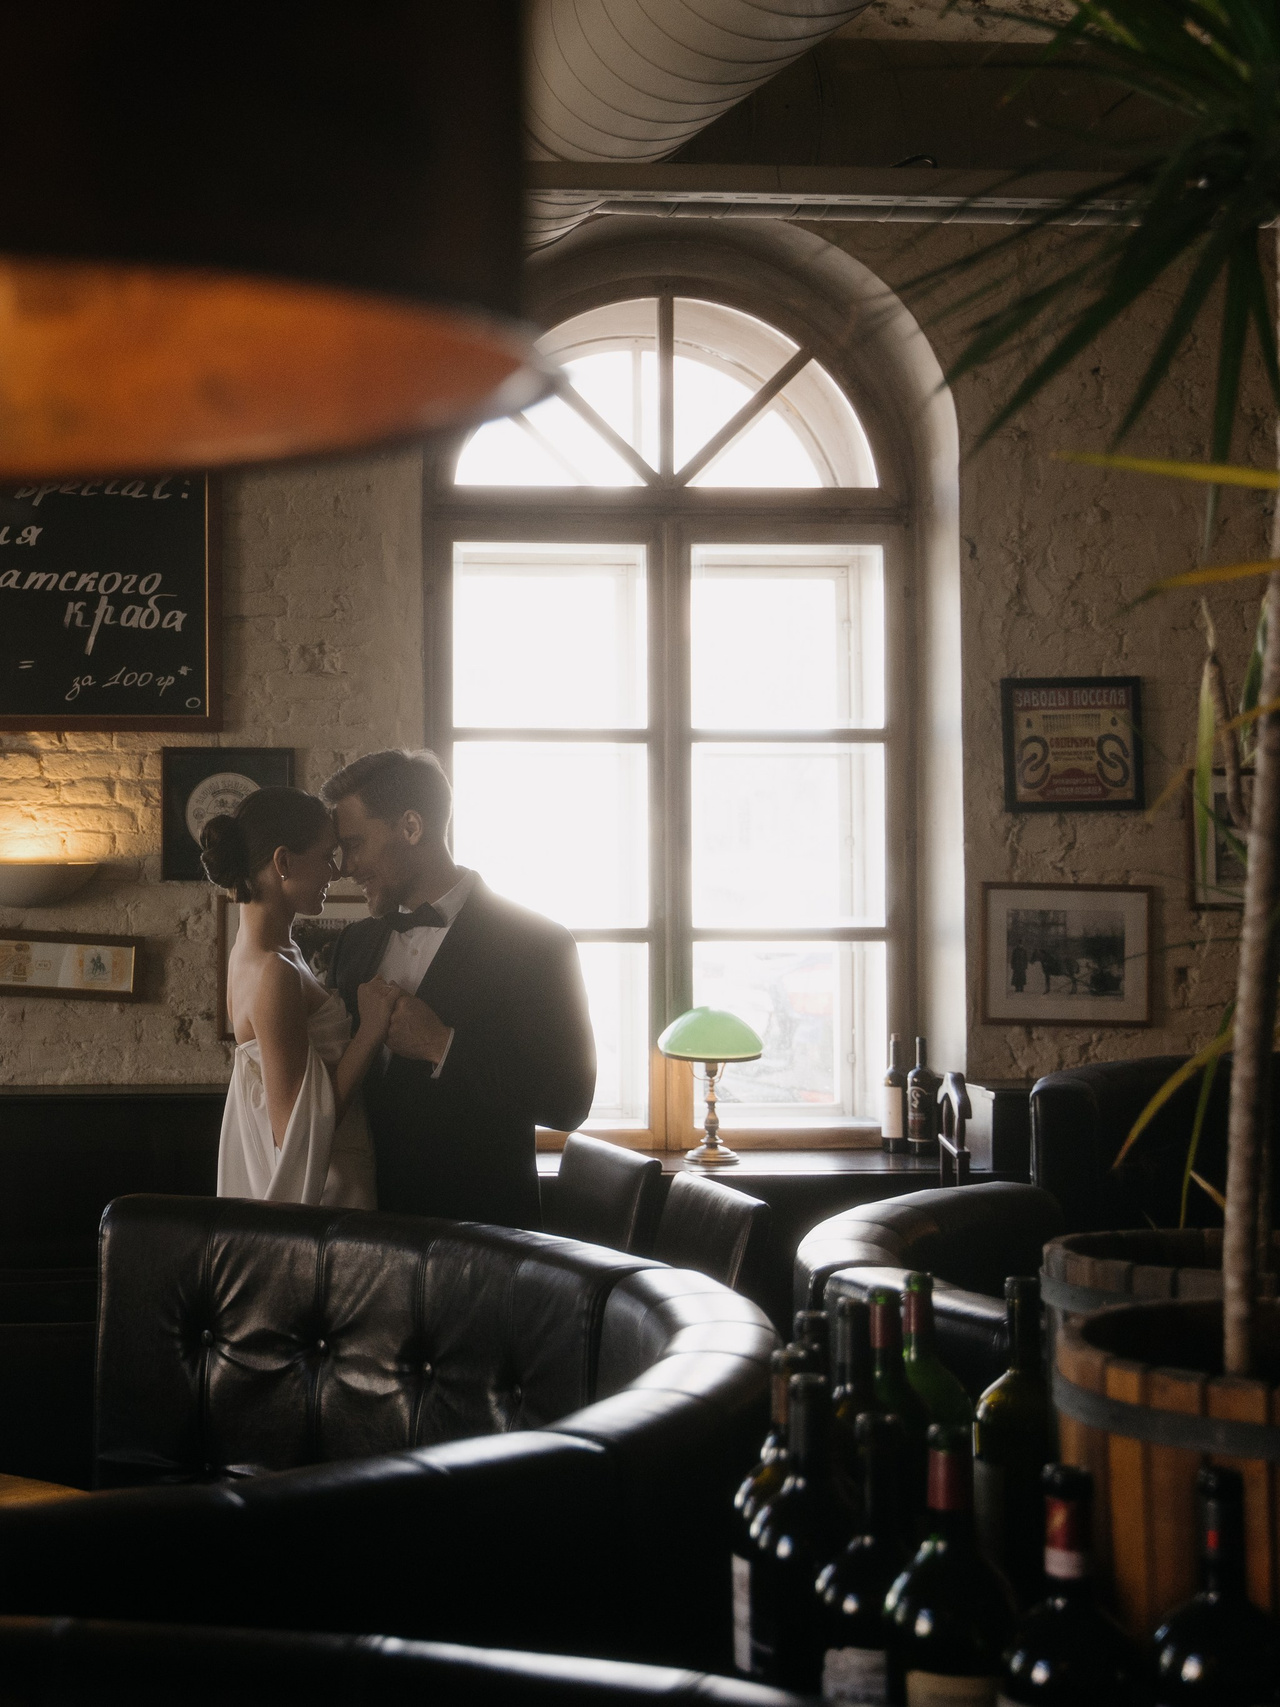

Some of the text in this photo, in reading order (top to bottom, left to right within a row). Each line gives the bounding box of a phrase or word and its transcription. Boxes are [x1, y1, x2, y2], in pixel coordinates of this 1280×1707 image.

[63, 594, 187, 655] краба
[65, 674, 97, 701] за
[1015, 688, 1126, 707] ЗАВОДЫ ПОССЕЛЯ
